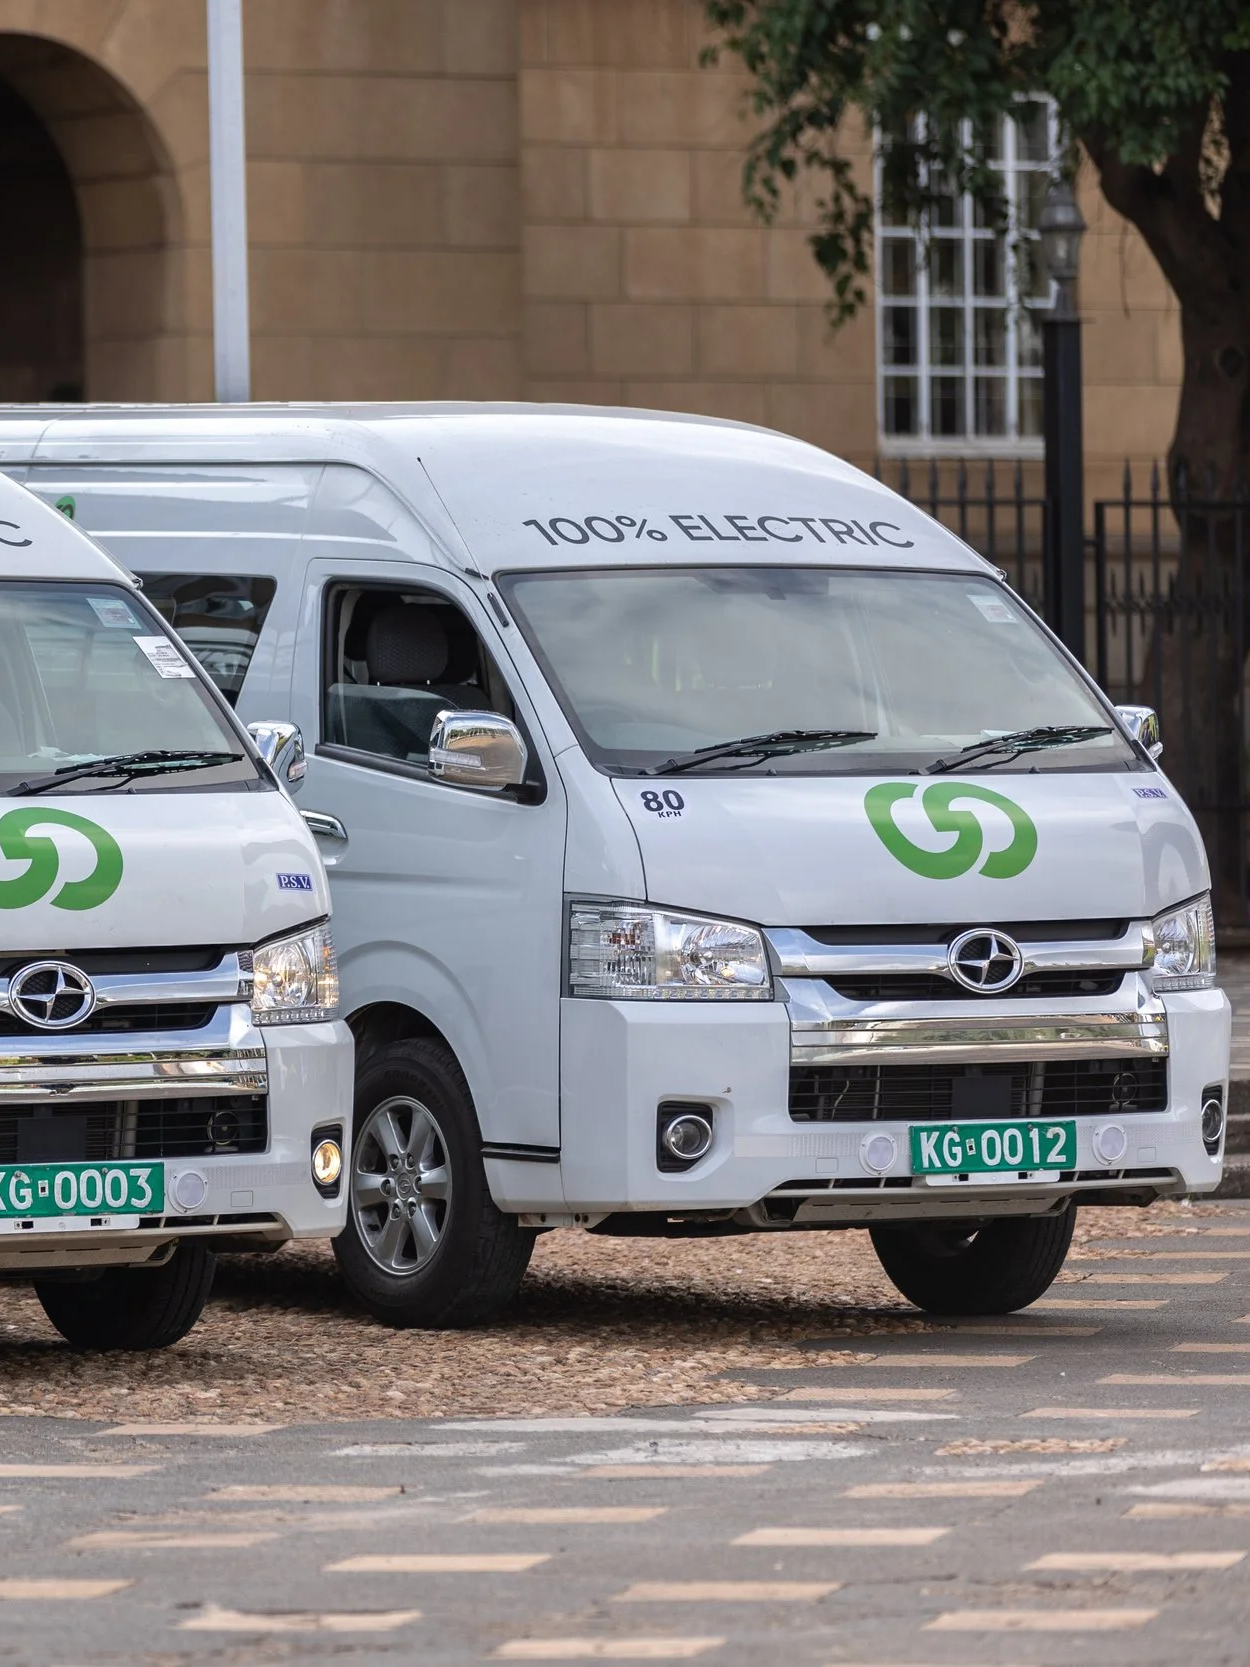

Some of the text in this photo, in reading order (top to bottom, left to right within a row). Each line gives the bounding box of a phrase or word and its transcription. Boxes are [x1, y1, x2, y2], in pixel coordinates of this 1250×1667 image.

[522, 515, 915, 549] 100% ELECTRIC
[640, 789, 684, 812] 80
[279, 875, 310, 889] P.S.V.
[919, 1127, 1068, 1168] KG 0012
[54, 1168, 153, 1210] 0003
